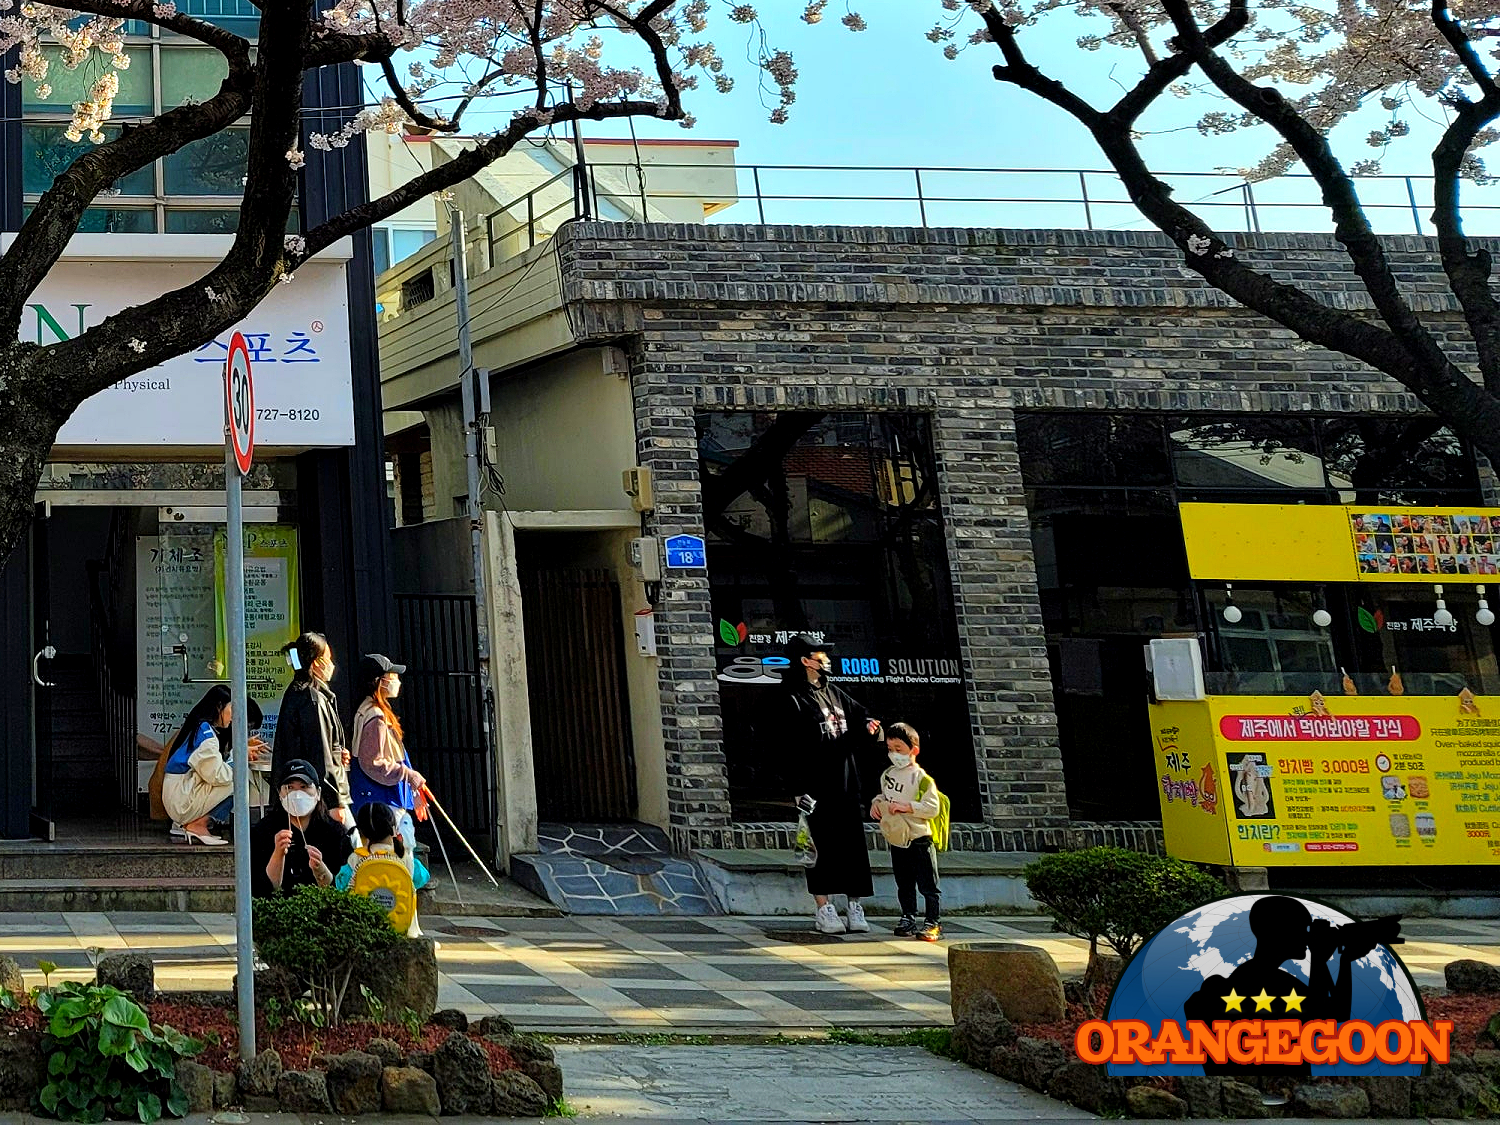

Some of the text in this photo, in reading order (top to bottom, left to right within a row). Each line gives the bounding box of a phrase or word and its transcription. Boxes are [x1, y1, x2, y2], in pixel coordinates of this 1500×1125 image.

[233, 367, 250, 435] 30
[256, 408, 320, 420] 727-8120
[679, 551, 694, 563] 18
[841, 658, 960, 676] ROBO SOLUTION
[1238, 719, 1402, 738] 제주에서 먹어봐야할 간식
[1165, 752, 1191, 775] 제주
[1321, 758, 1370, 774] 3,000원
